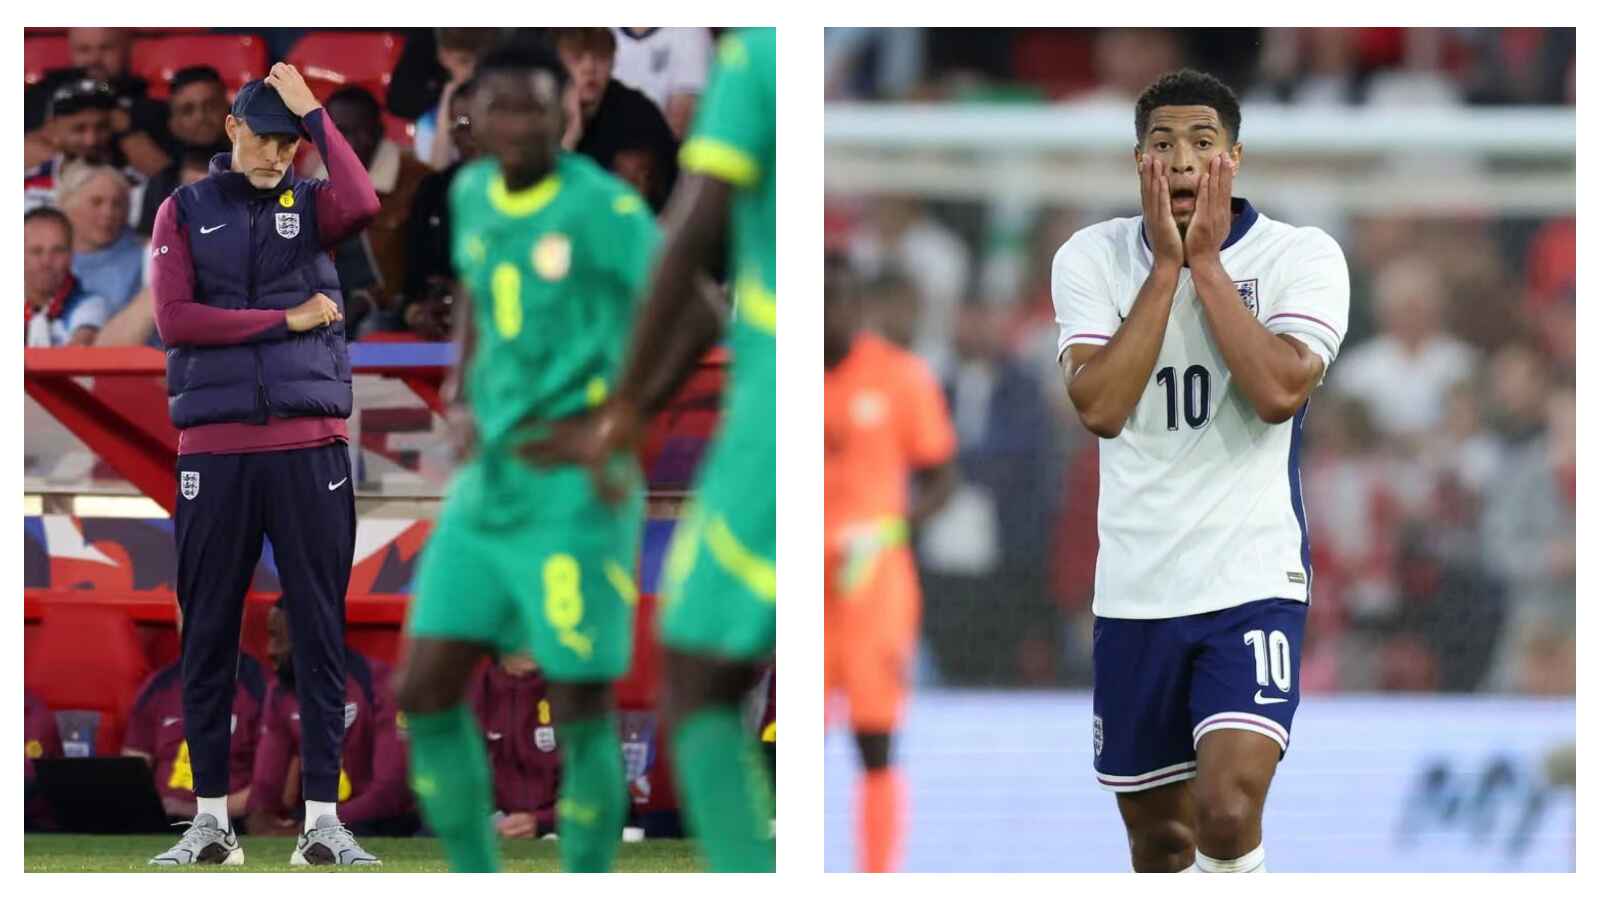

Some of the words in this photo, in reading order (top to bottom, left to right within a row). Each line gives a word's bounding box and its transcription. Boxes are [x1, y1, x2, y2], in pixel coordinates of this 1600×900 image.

[1157, 365, 1211, 431] 10
[543, 554, 583, 627] 8
[1243, 629, 1291, 692] 10
